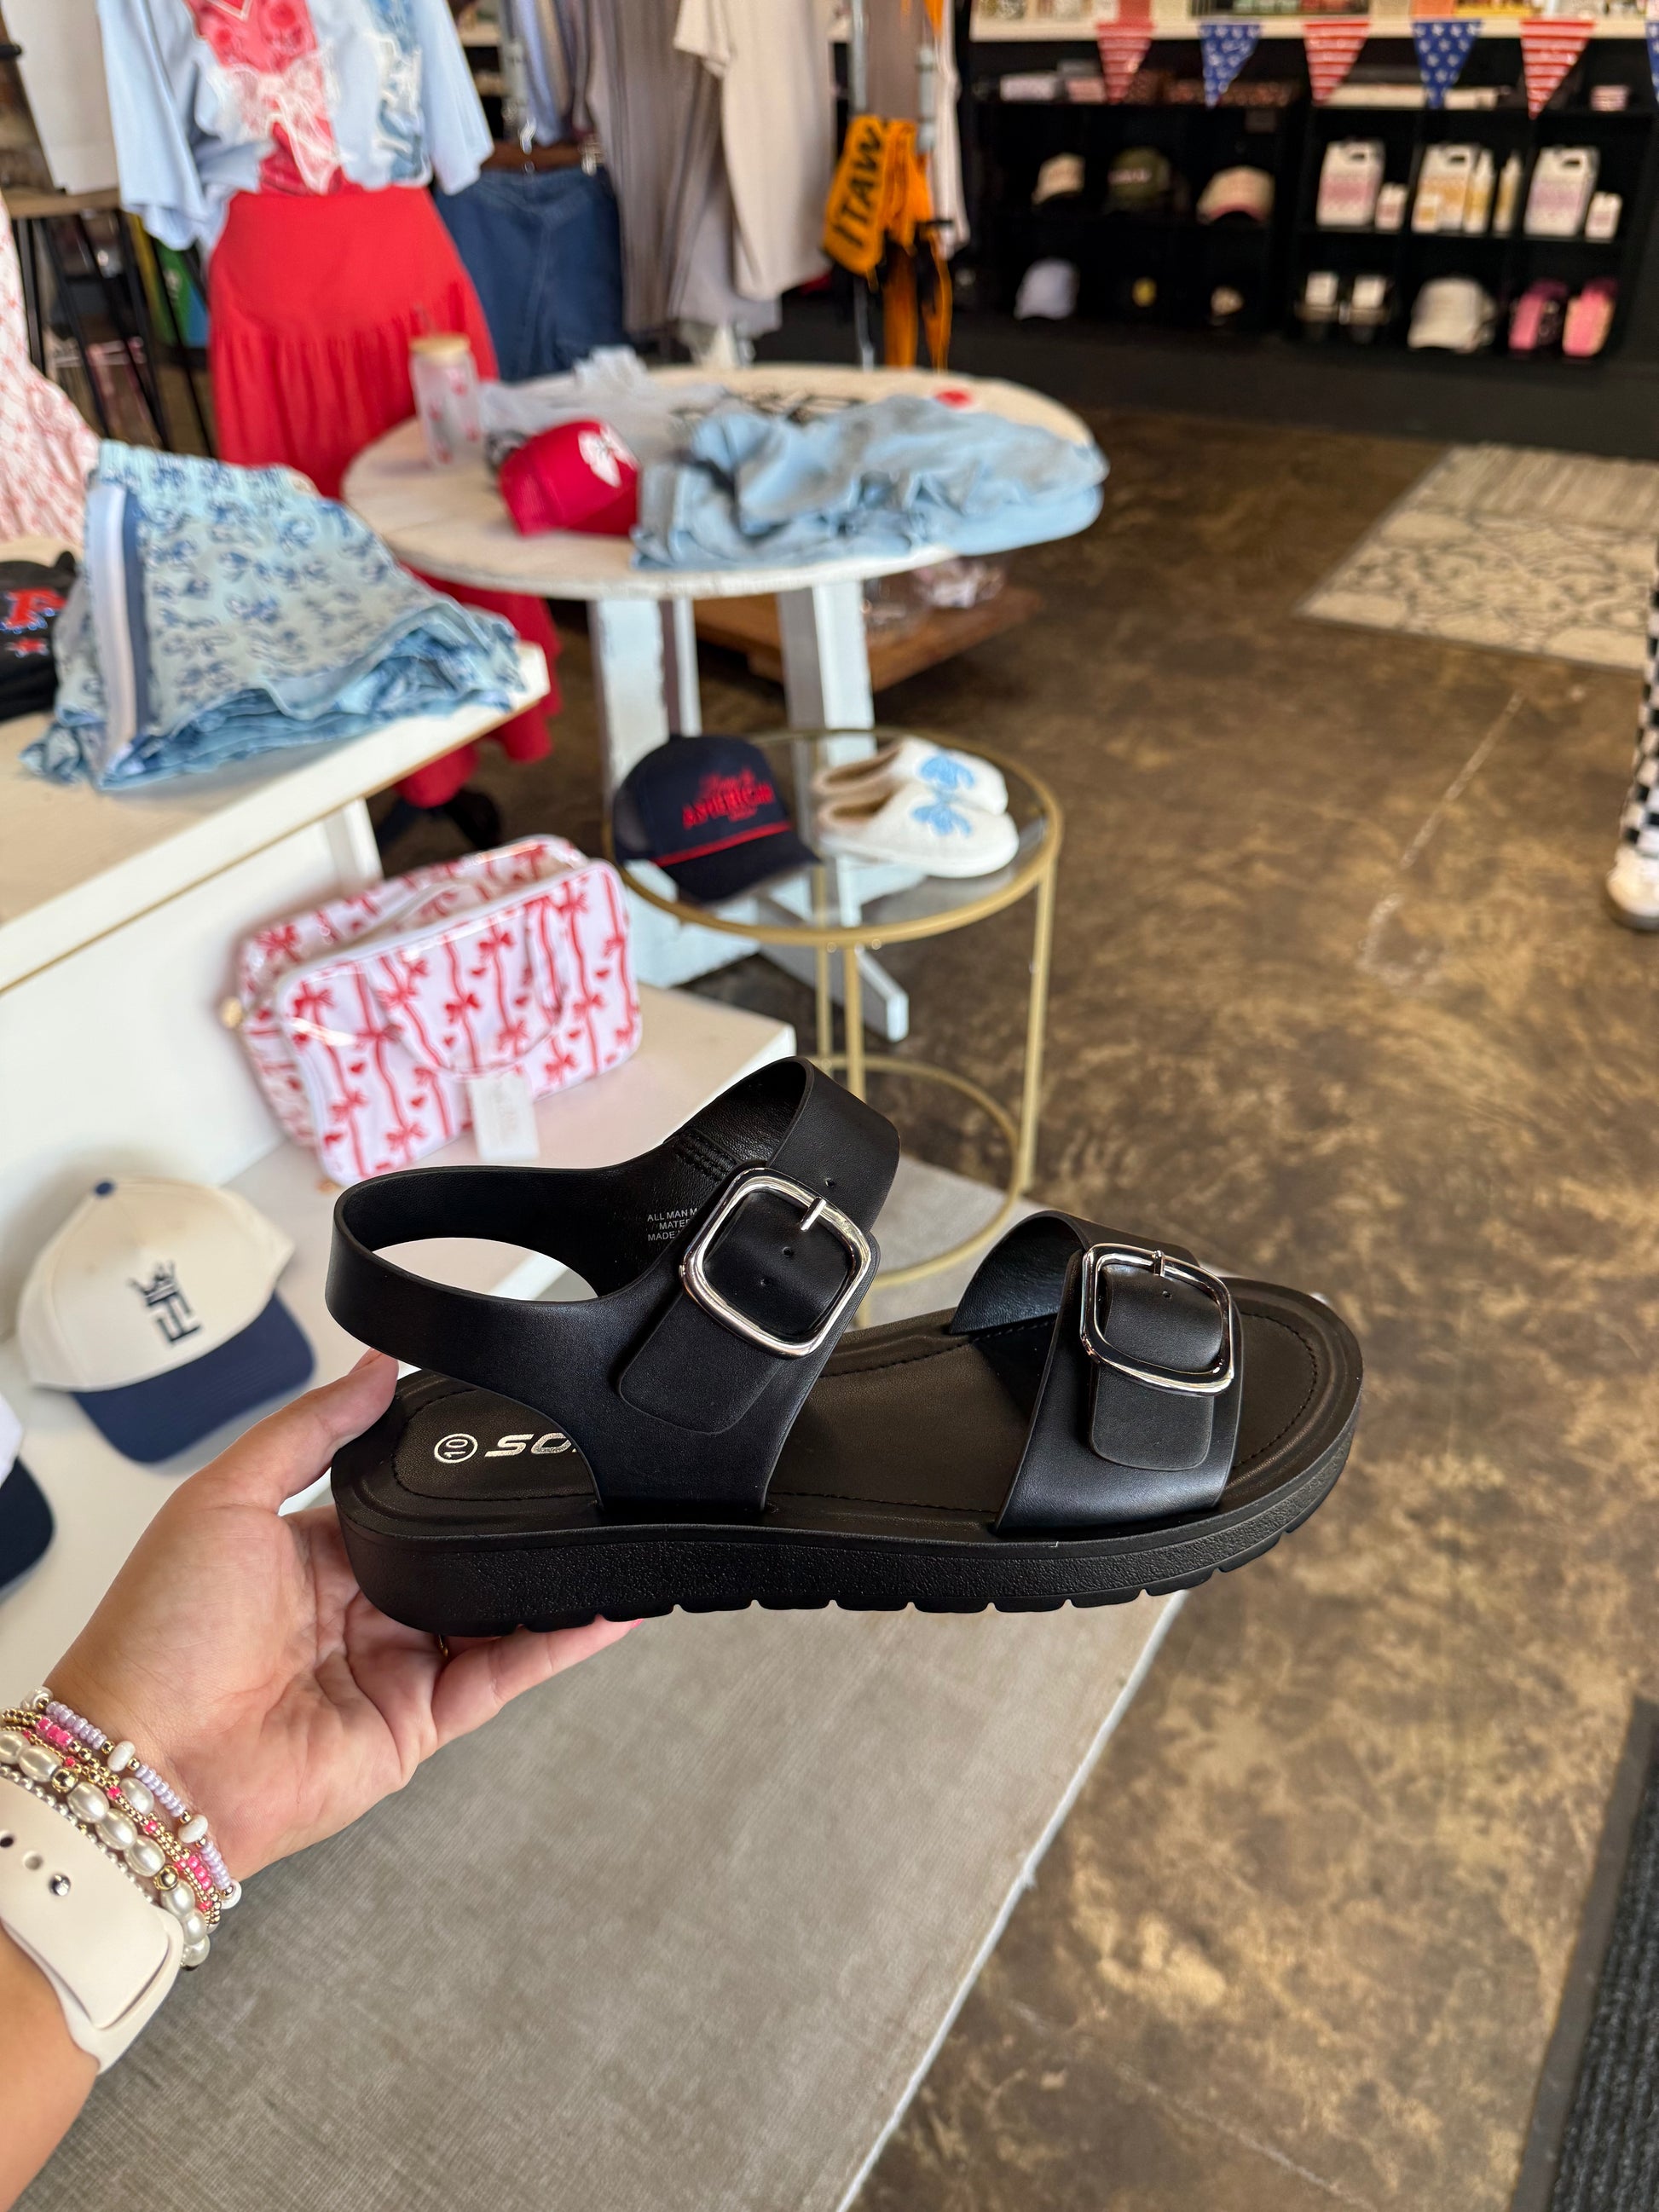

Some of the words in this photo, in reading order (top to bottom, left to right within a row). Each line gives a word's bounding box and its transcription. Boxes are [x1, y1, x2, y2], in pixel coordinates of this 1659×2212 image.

[647, 1213, 665, 1222] ALL
[667, 1209, 688, 1220] MAN
[647, 1230, 676, 1241] MADE
[484, 1432, 577, 1458] SO
